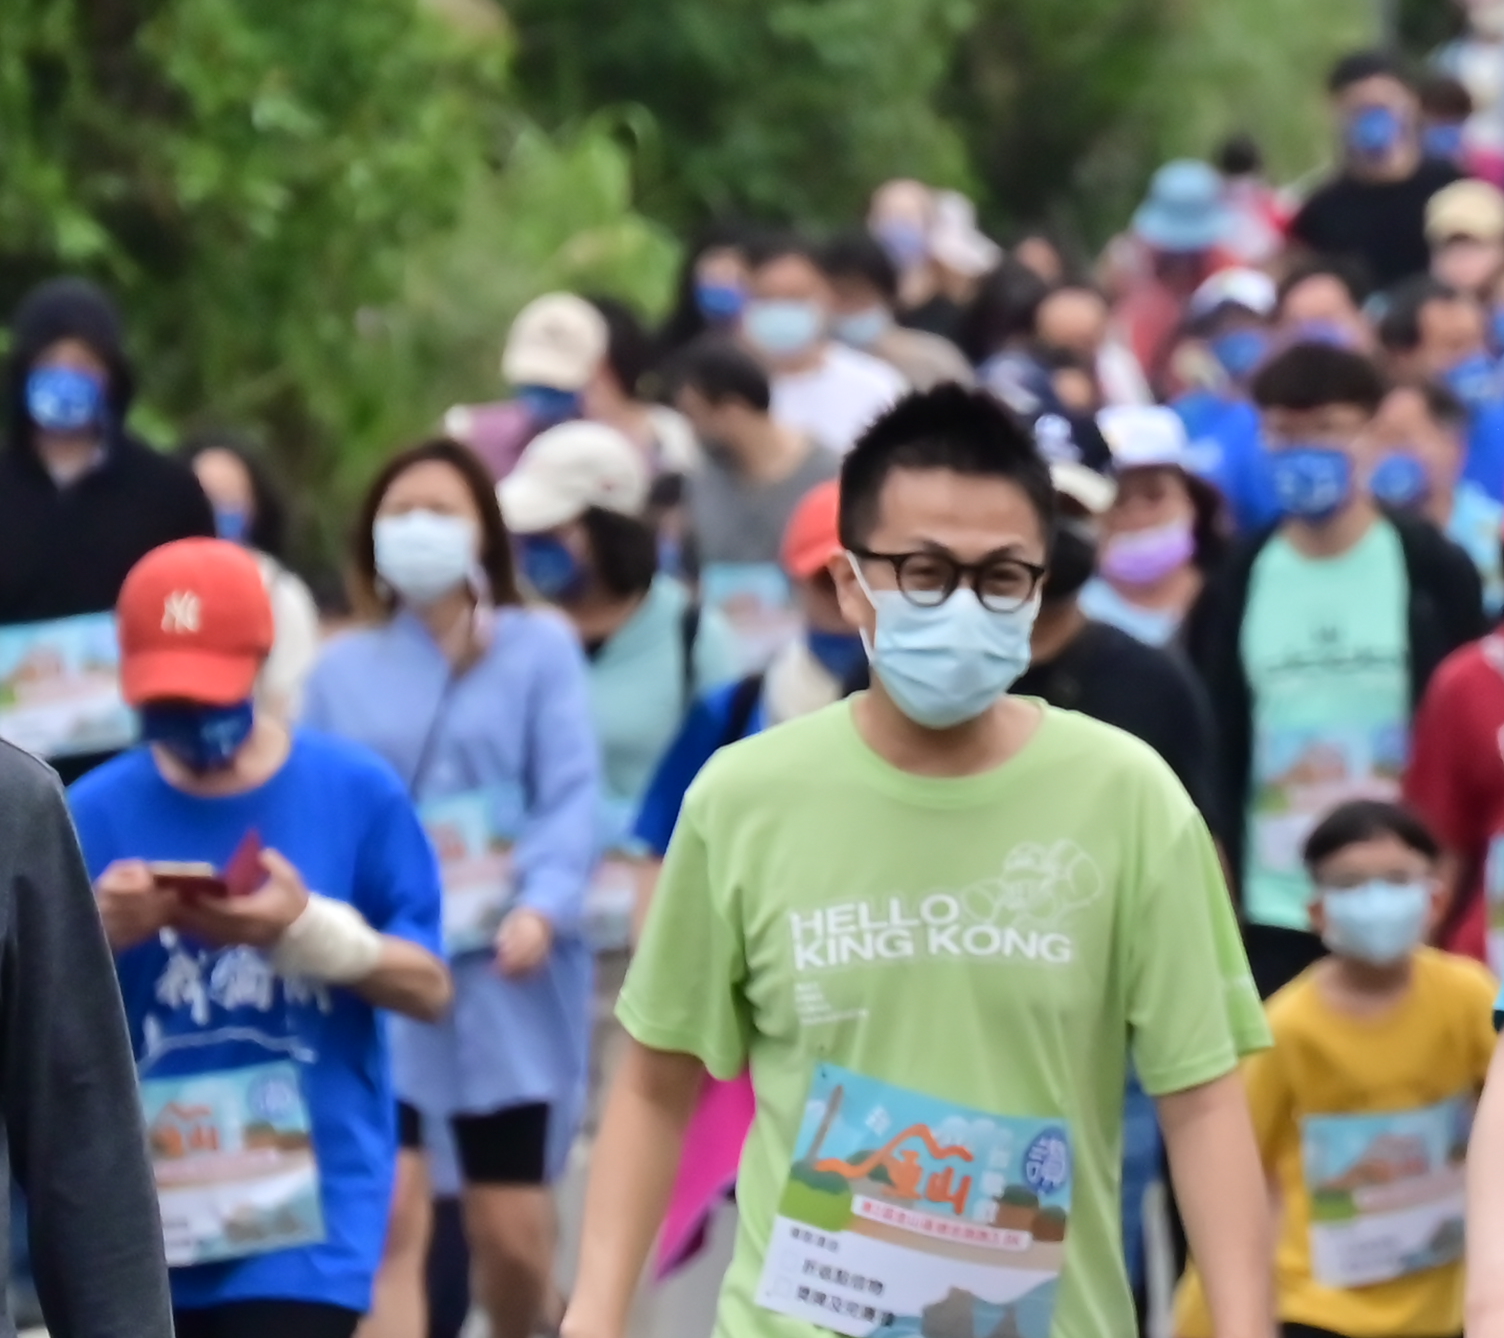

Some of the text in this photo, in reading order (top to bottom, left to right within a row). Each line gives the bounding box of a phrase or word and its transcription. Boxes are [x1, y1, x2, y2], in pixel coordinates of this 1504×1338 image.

[790, 894, 959, 941] HELLO
[795, 924, 1071, 971] KING KONG
